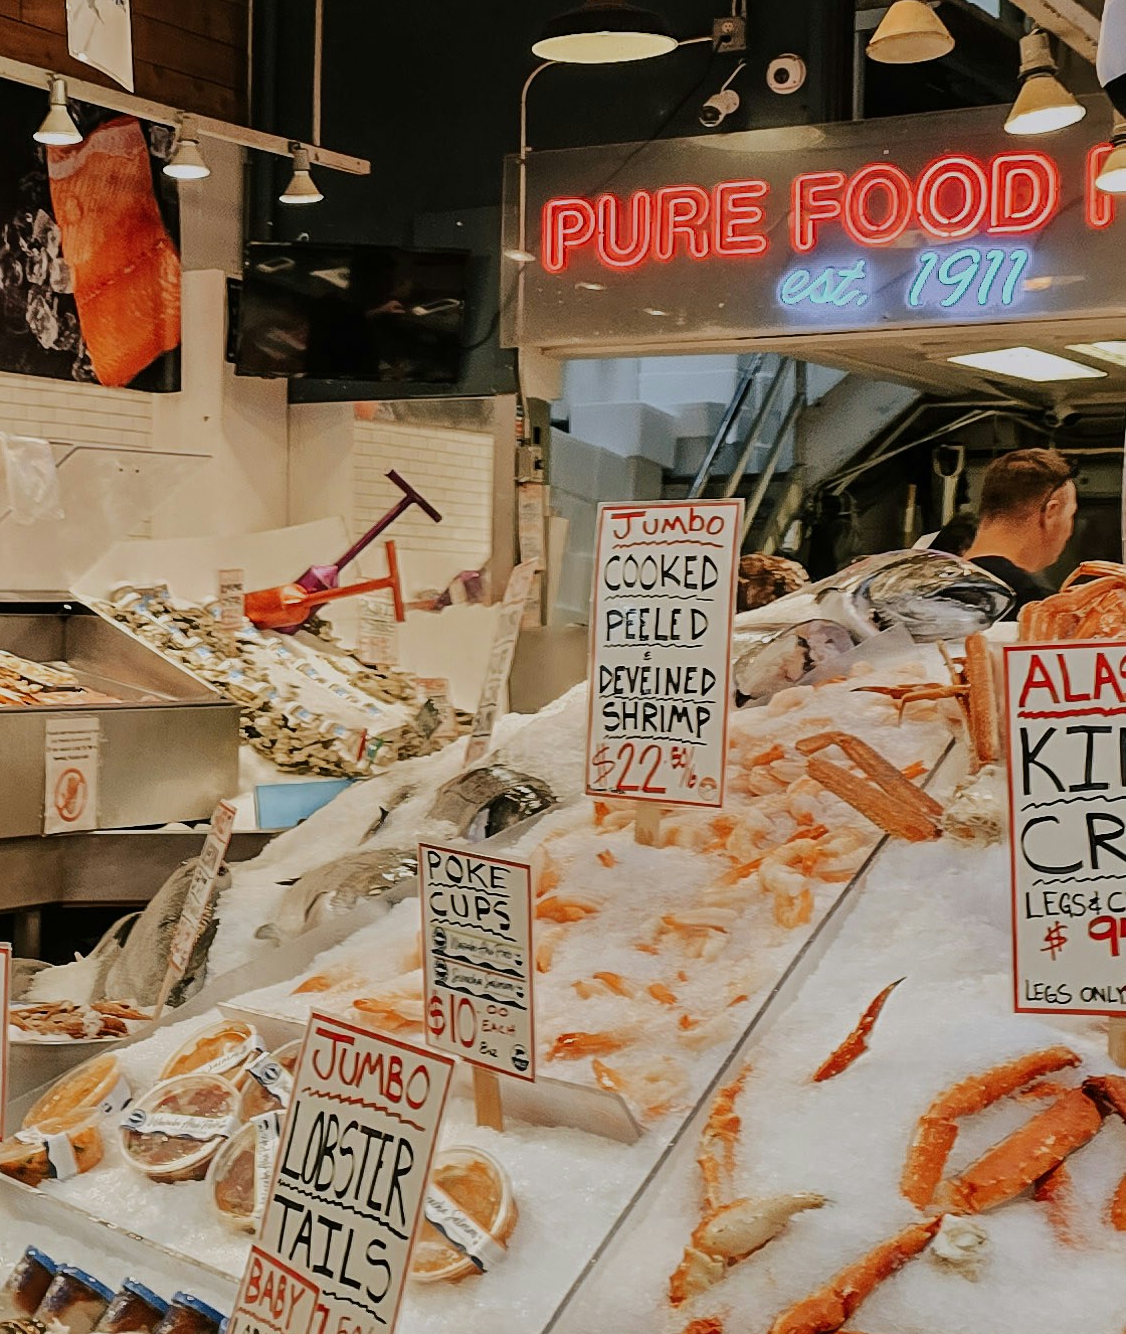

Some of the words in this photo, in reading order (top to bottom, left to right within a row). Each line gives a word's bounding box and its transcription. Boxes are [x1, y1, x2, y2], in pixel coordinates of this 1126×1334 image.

[541, 179, 770, 272] PURE
[791, 150, 1059, 252] FOOD
[781, 260, 868, 308] est.
[909, 248, 1030, 309] 1911
[604, 554, 718, 592] COOKED
[606, 607, 708, 642] PEELED
[599, 664, 717, 697] DEVEINED
[602, 701, 711, 739] SHRIMP
[1020, 725, 1126, 796] KI
[1020, 812, 1126, 875] CR
[427, 850, 511, 890] POKE
[429, 891, 511, 931] CUPS
[1026, 891, 1086, 919] LEGS
[1025, 979, 1072, 1004] LEGS
[482, 1019, 516, 1035] EACH
[312, 1027, 430, 1110] JUMBO
[280, 1100, 414, 1228] LOBSTER
[274, 1193, 392, 1304] TAILS
[245, 1257, 306, 1330] BABY
